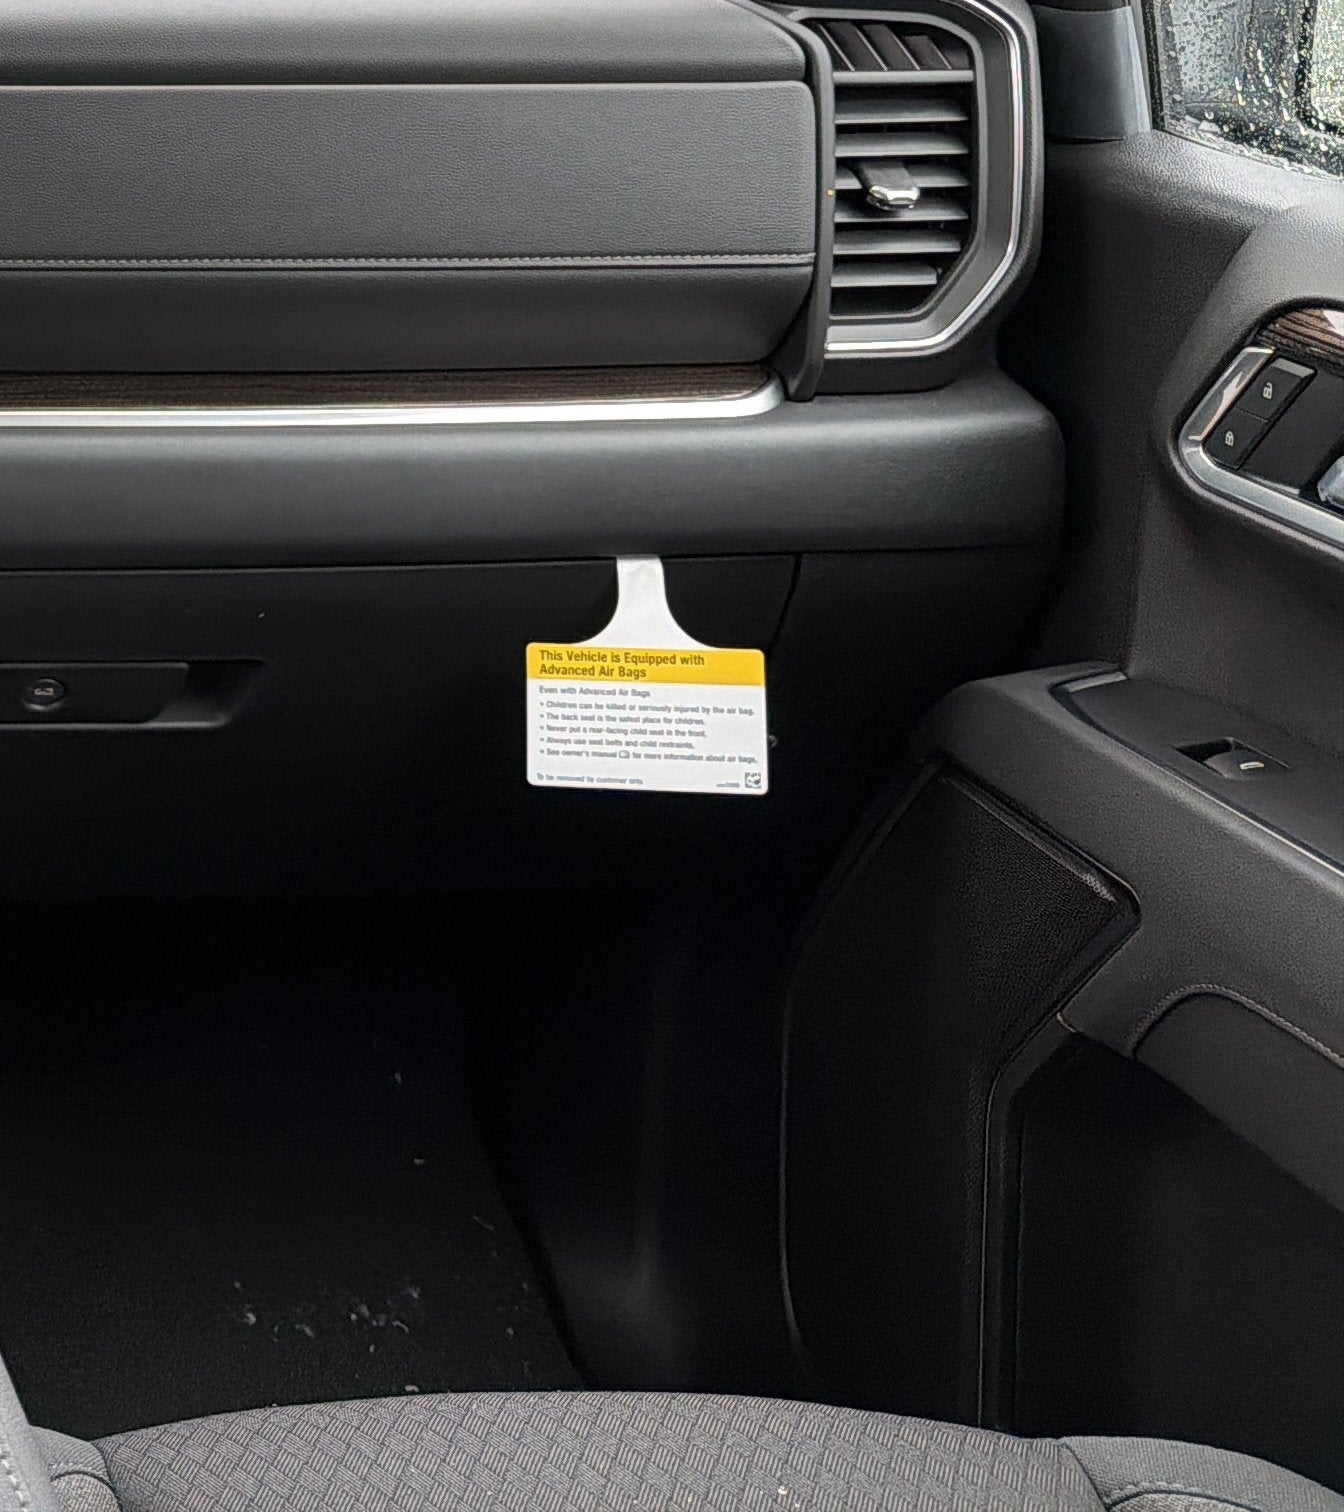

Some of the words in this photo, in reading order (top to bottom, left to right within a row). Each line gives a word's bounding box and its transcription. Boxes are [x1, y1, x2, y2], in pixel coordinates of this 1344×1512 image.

[539, 649, 563, 661] This
[565, 650, 607, 662] Vehicle
[609, 651, 620, 663] is
[622, 651, 677, 666] Equipped
[679, 653, 705, 665] with
[539, 663, 595, 676] Advanced
[597, 665, 615, 677] Air
[617, 665, 647, 680] Bags
[538, 685, 558, 693] Even
[578, 686, 616, 695] Advanced
[630, 688, 650, 697] Bags
